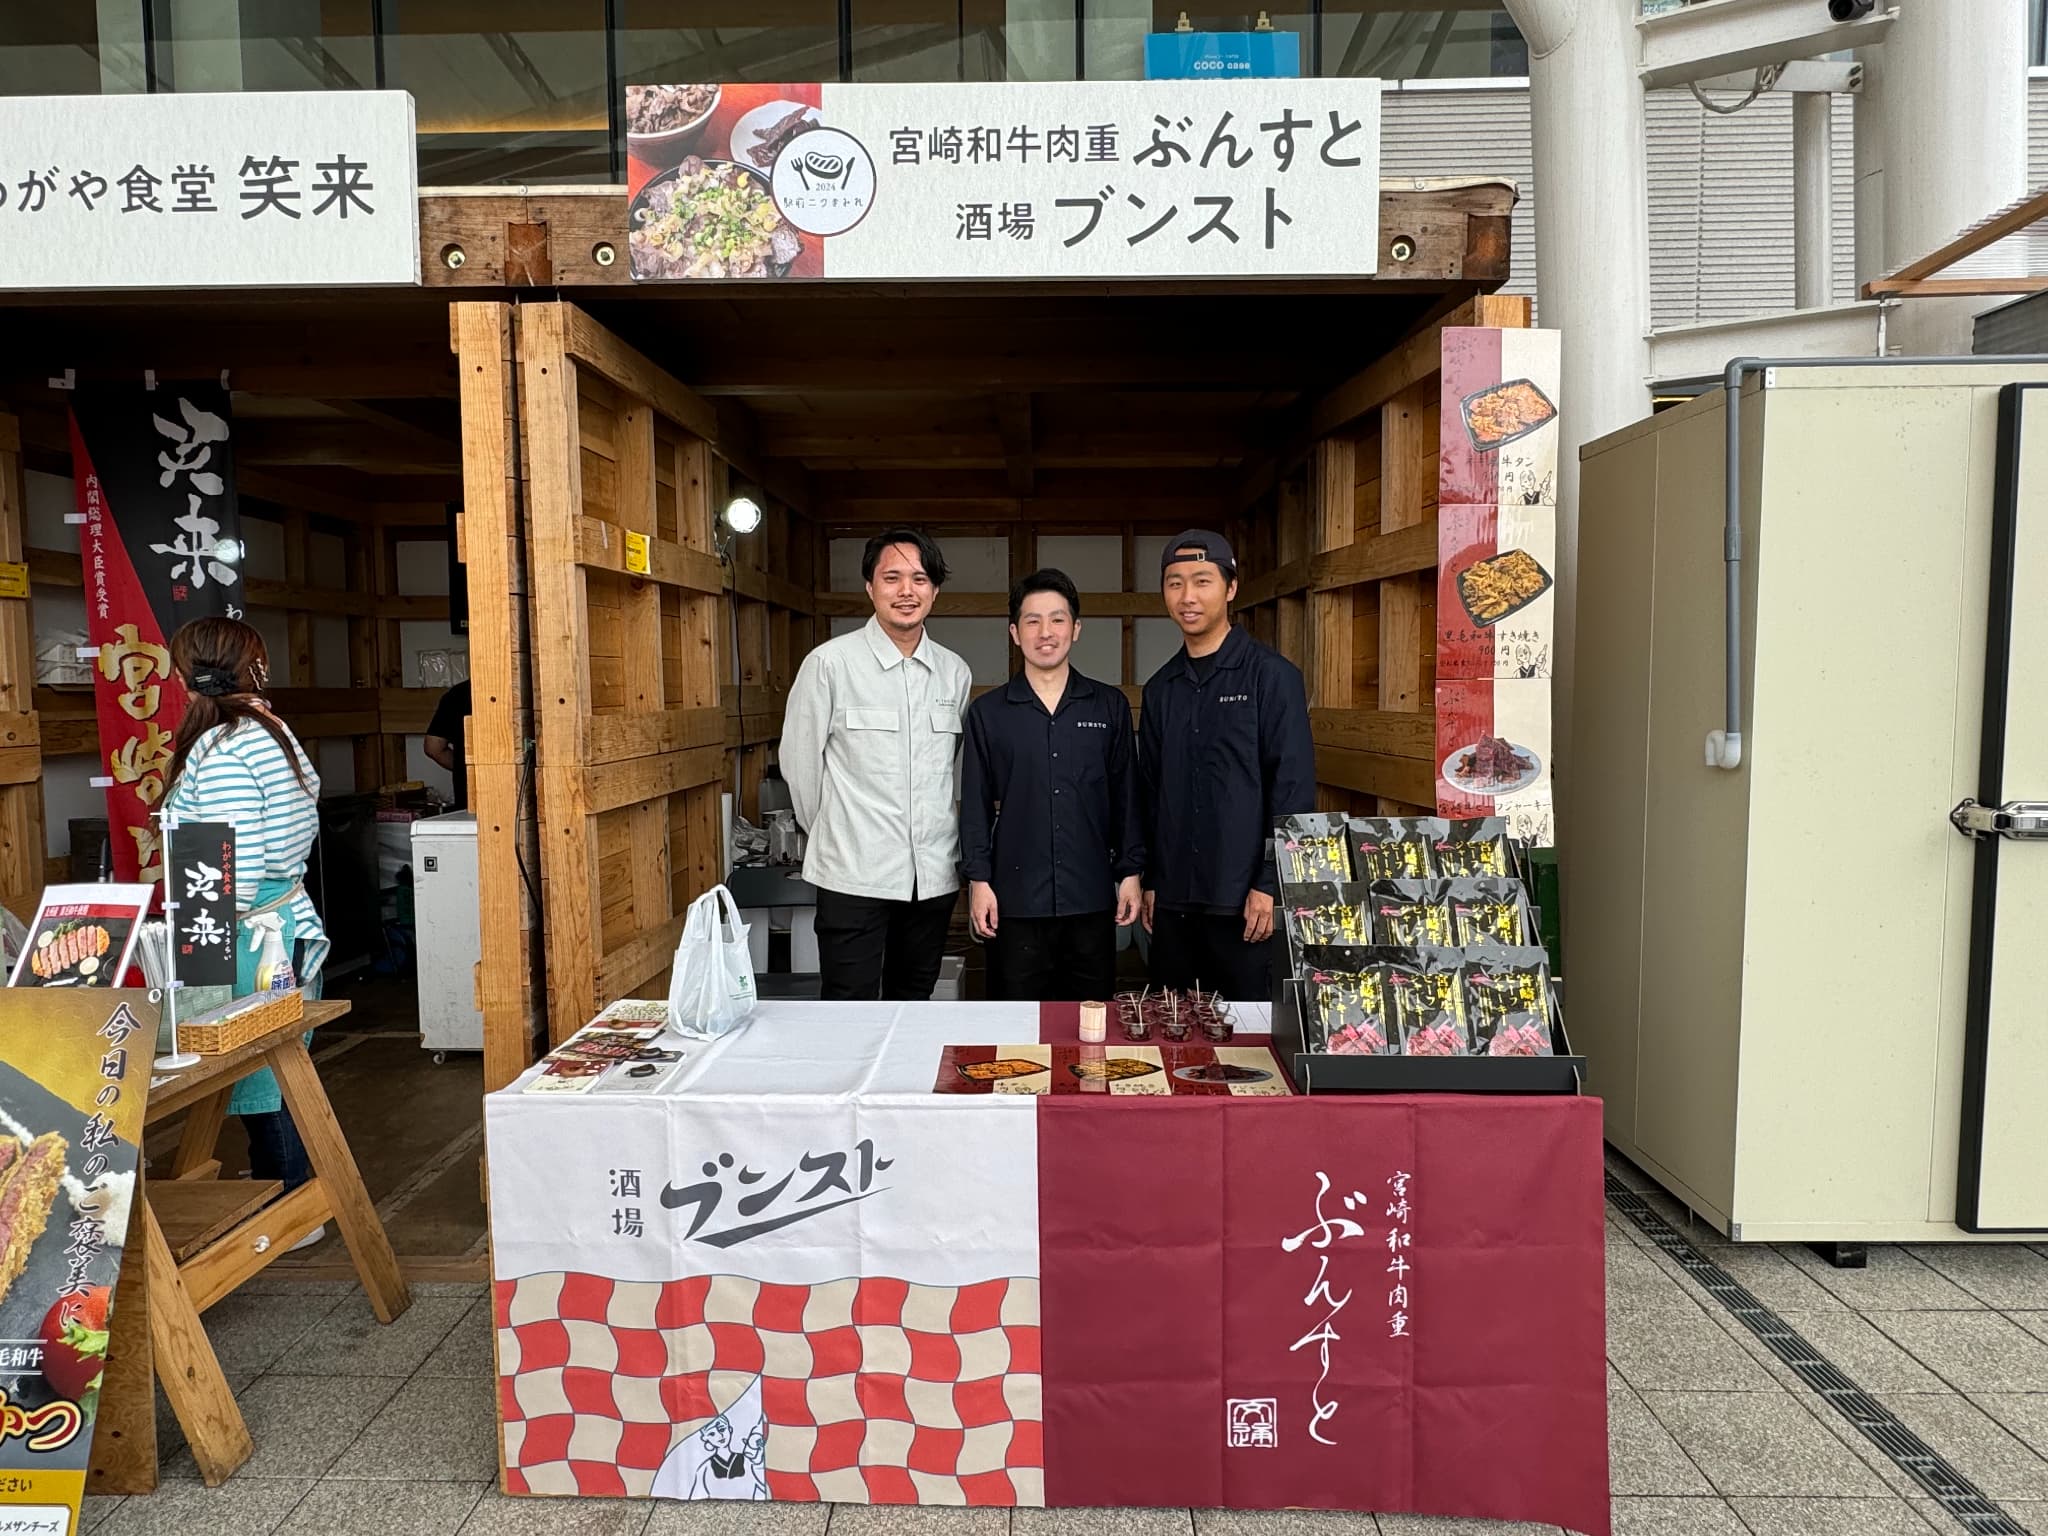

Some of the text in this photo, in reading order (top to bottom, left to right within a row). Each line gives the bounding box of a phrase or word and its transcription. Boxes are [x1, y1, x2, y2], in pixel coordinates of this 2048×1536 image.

[889, 109, 1362, 173] 宮崎和牛肉重 ぶんすと
[238, 153, 375, 220] 笑来
[815, 182, 836, 191] 2024
[955, 185, 1293, 249] 酒場 ブンスト
[57, 1003, 142, 1327] 今日の私のご褒美に
[609, 1139, 895, 1241] 酒場 ブンスト
[1386, 1171, 1412, 1338] 宮崎和牛肉重
[1281, 1171, 1368, 1445] ぶんすと
